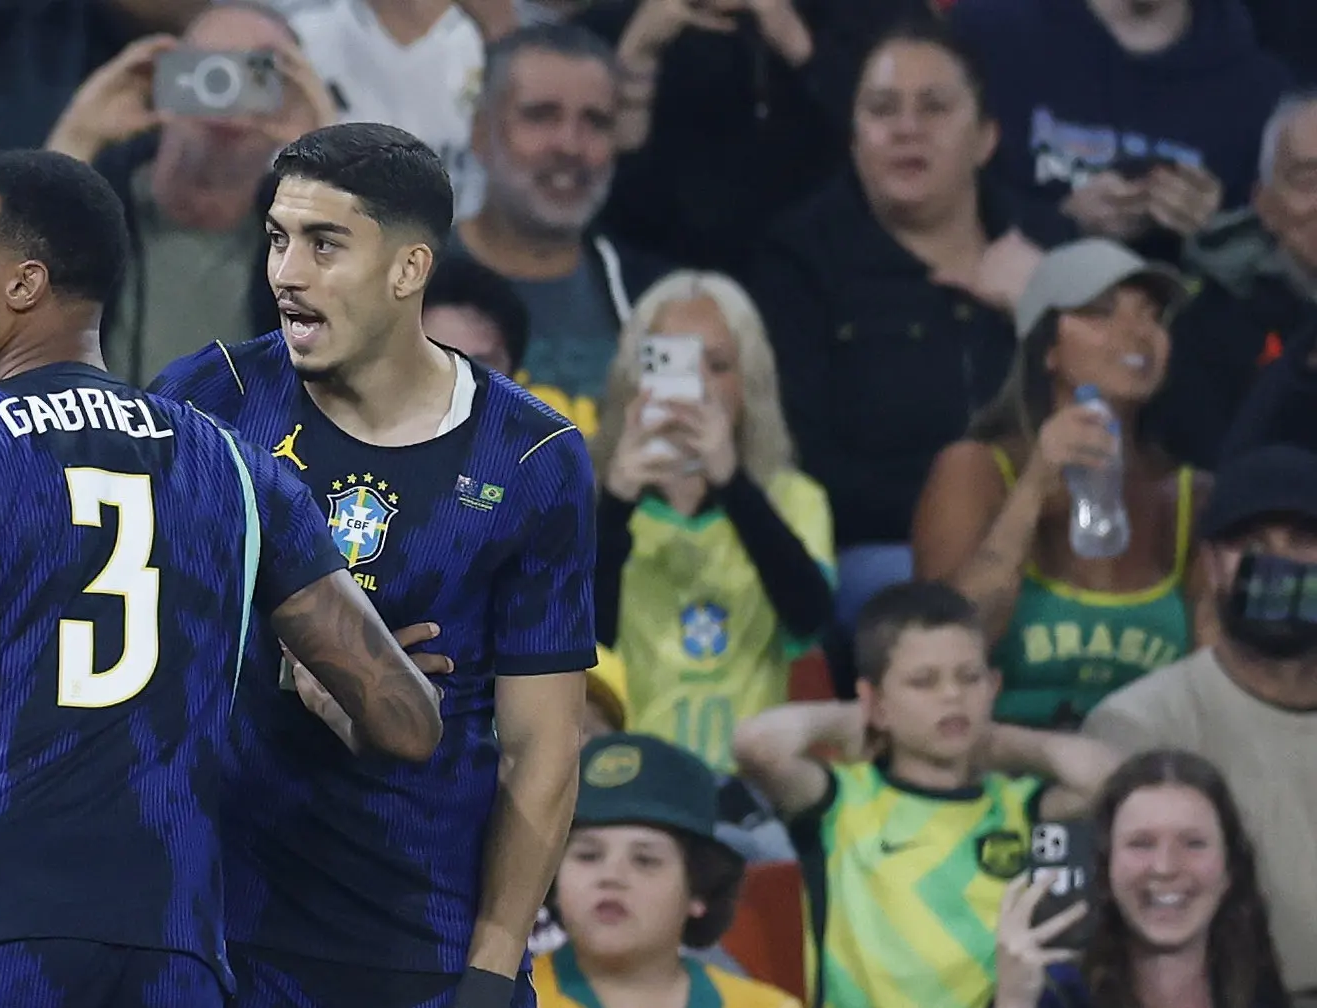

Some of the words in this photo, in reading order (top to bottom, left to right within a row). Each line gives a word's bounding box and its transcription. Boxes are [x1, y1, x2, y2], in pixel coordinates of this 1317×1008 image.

[346, 518, 370, 530] CBF
[58, 467, 160, 708] 3
[353, 573, 377, 591] SIL
